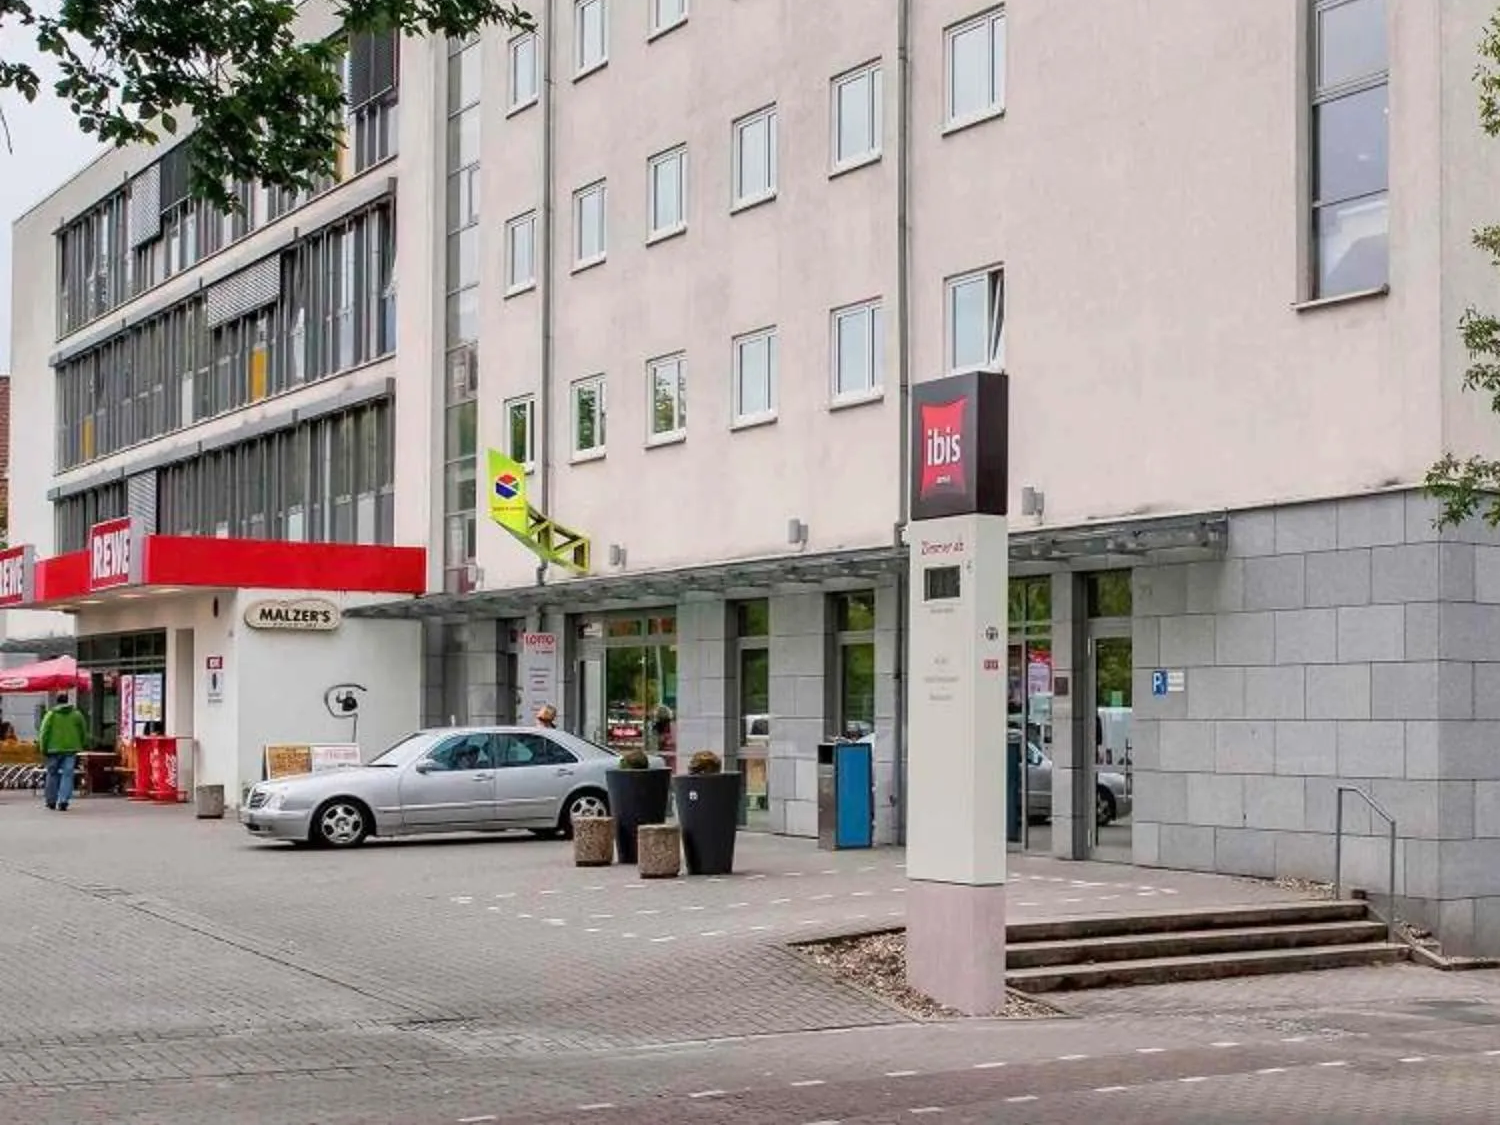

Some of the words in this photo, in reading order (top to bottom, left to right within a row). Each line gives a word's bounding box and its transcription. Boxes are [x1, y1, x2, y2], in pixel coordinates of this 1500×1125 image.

[927, 427, 961, 467] ibis
[94, 530, 130, 581] REWE
[259, 608, 331, 623] MALZER'S
[525, 634, 554, 645] LOTTO
